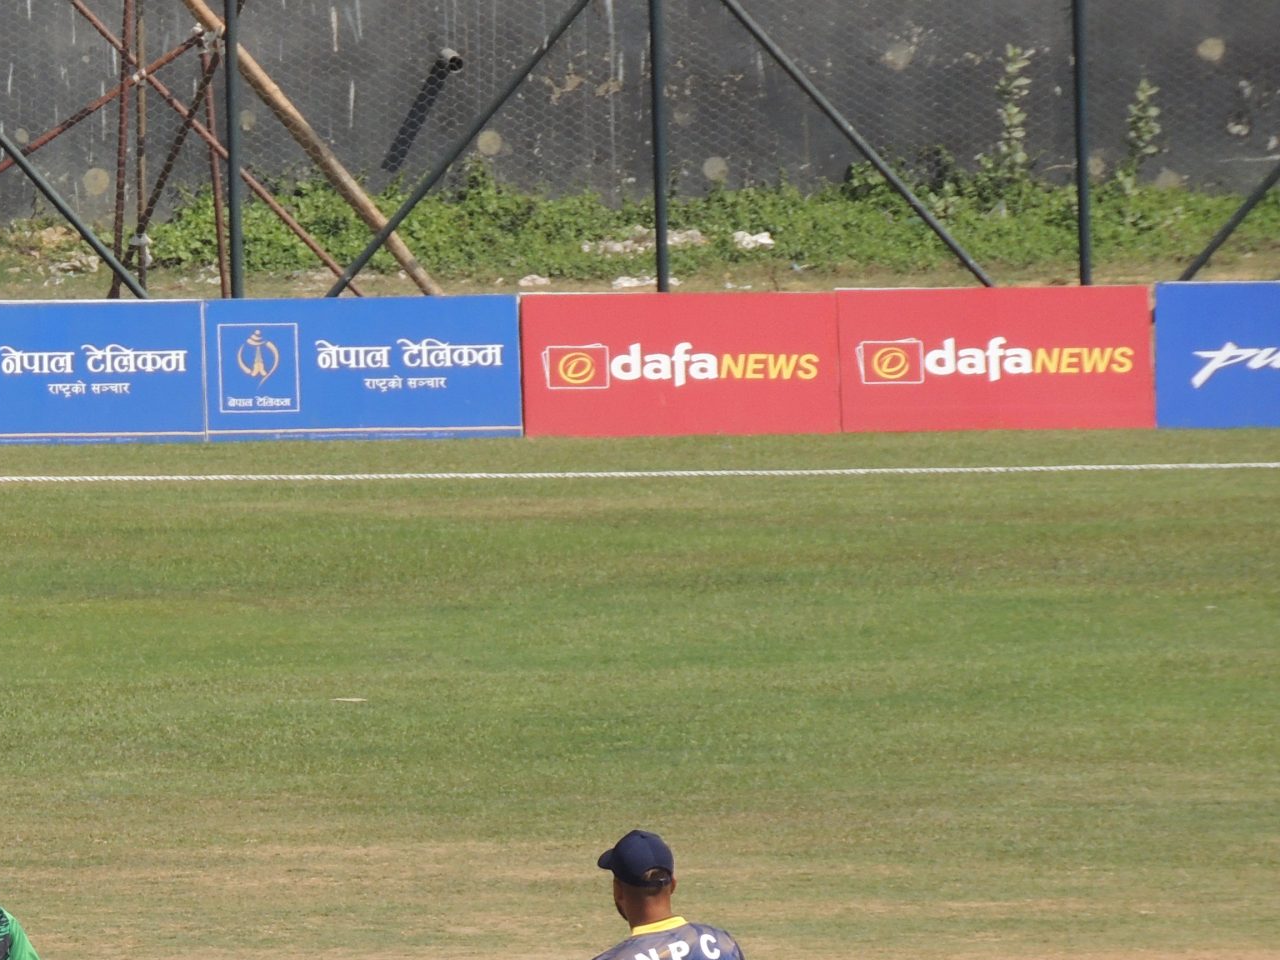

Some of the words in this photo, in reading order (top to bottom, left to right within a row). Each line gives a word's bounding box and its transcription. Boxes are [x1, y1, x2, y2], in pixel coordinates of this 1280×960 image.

[0, 345, 75, 374] नेपाल
[81, 343, 188, 373] टेलिकम
[315, 339, 392, 369] नेपाल
[396, 338, 504, 368] टेलिकम
[609, 341, 820, 388] dafaNEWS
[924, 336, 1134, 383] dafaNEWS
[47, 380, 87, 399] राष्ट्रको
[364, 375, 403, 393] राष्ट्रको
